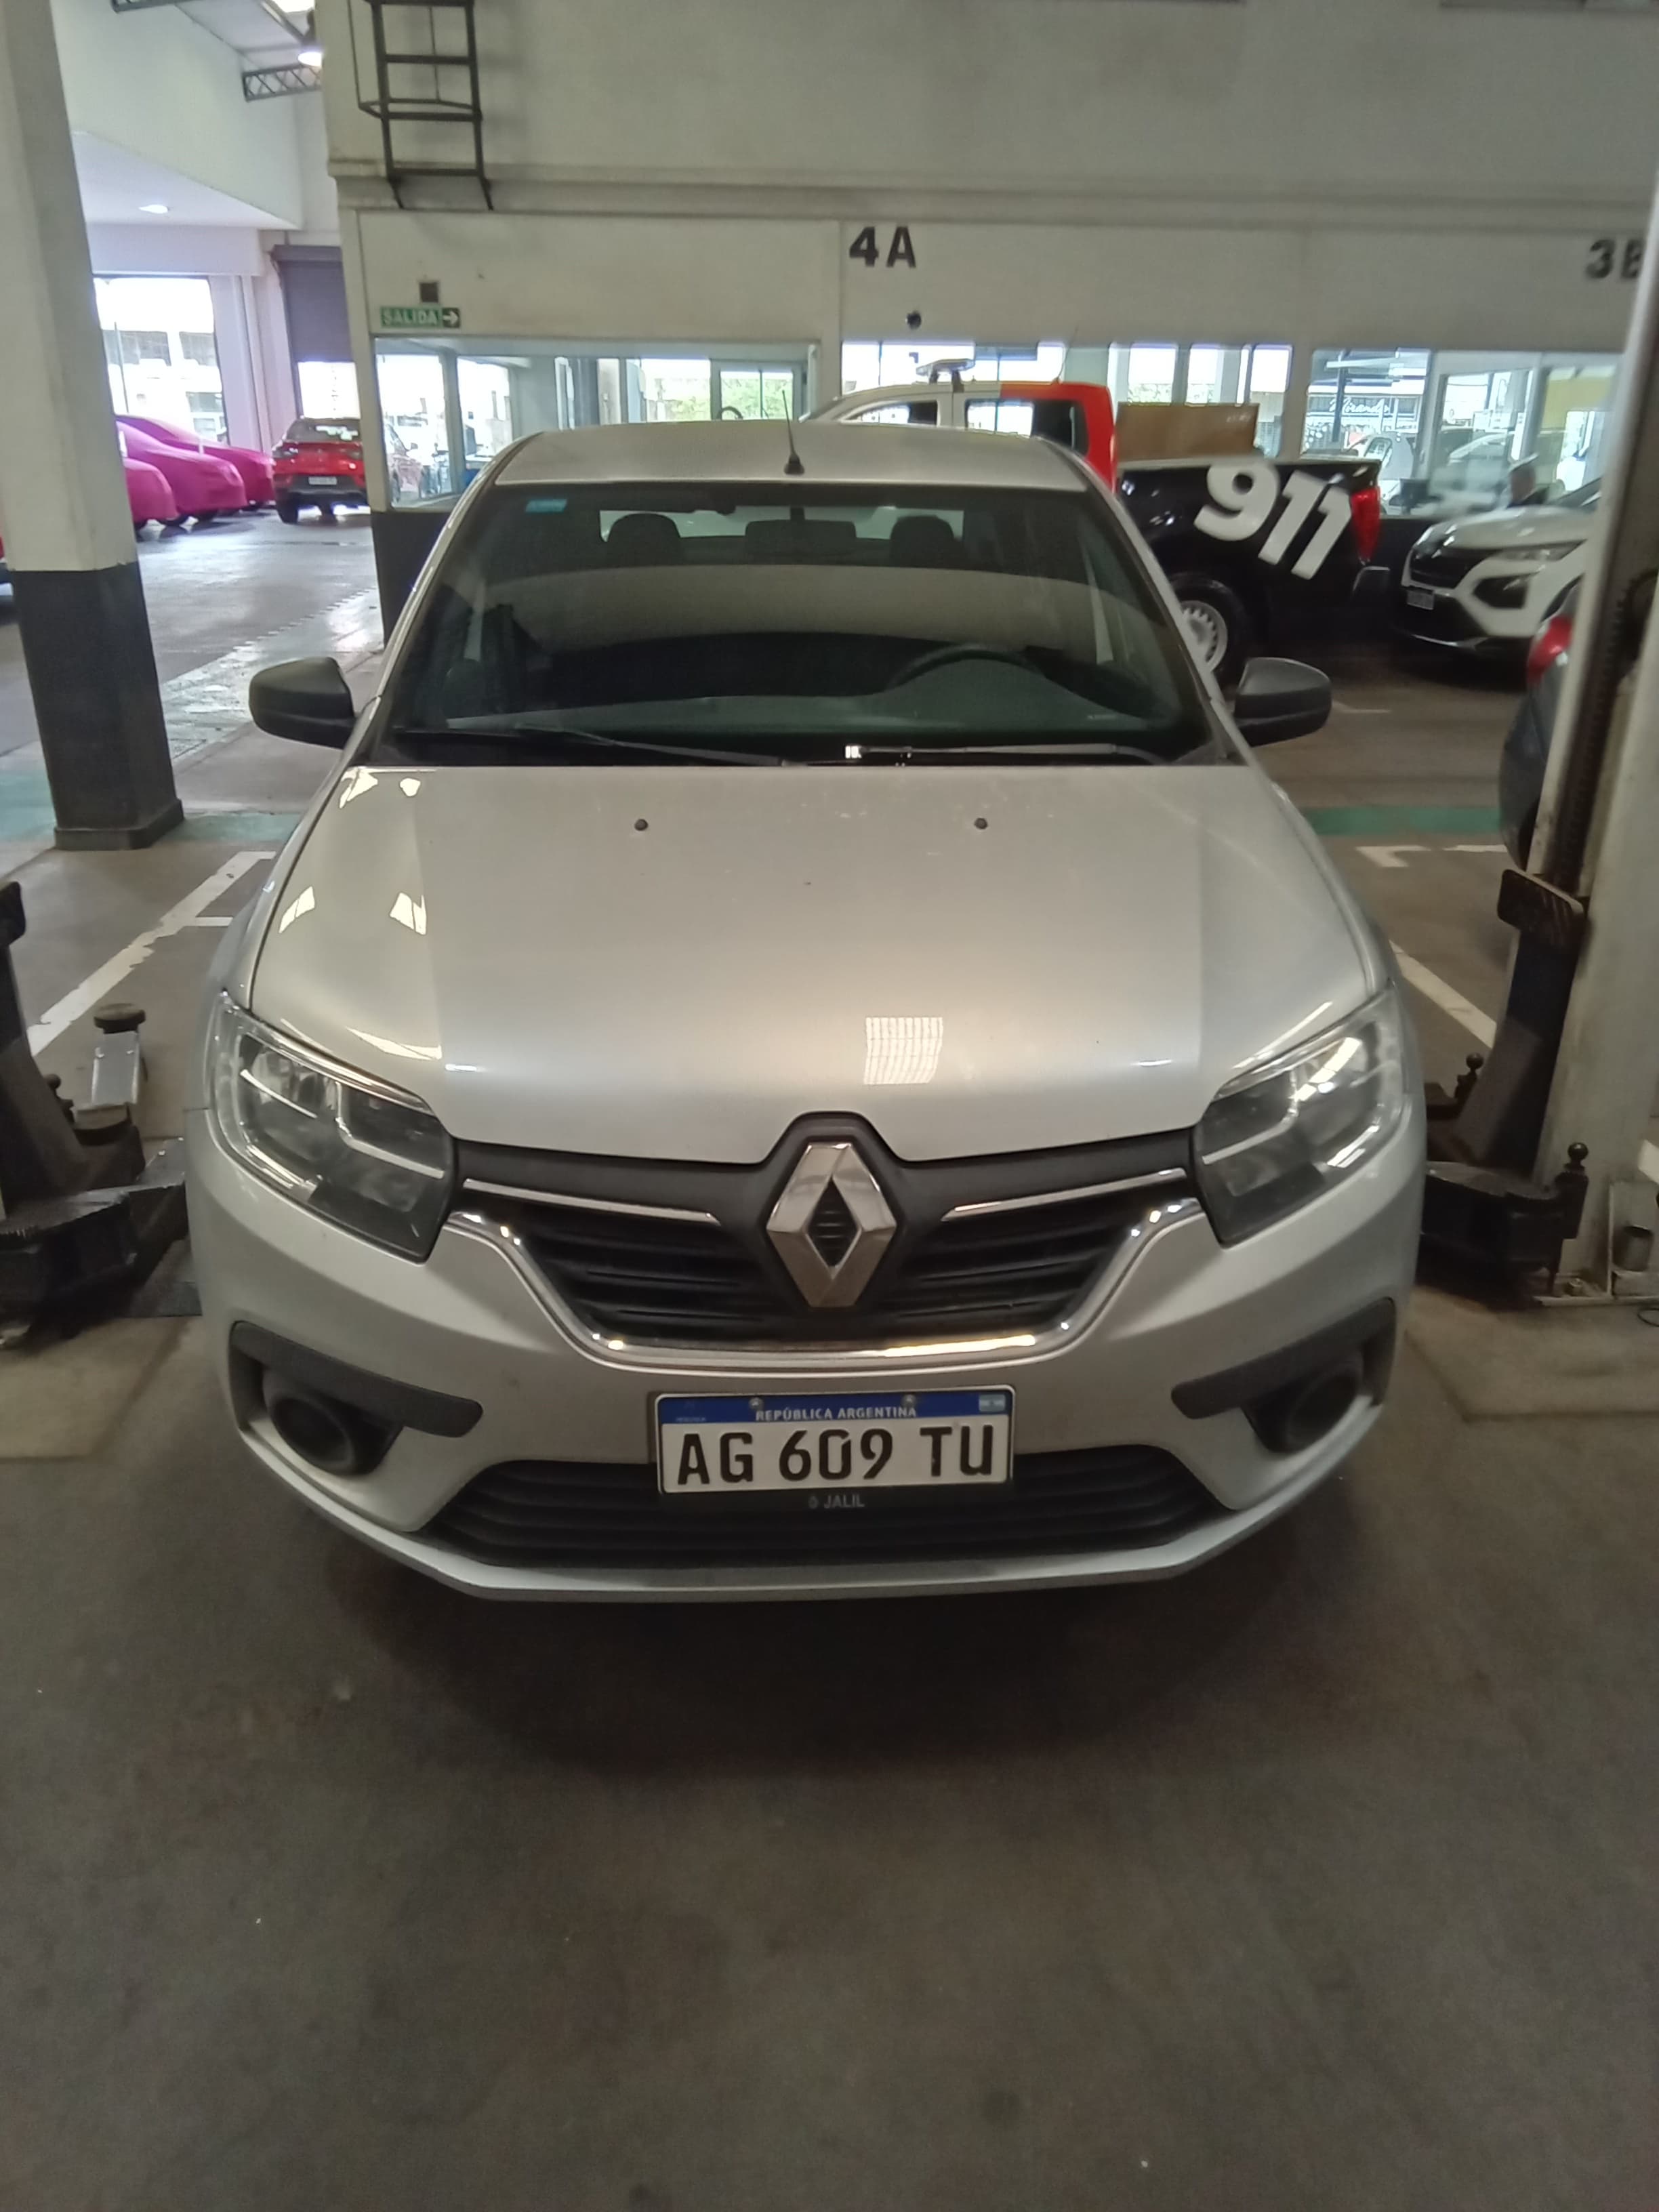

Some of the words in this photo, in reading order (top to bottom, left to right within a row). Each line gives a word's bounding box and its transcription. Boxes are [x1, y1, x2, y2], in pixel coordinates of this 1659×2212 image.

[382, 309, 438, 325] SALIDA
[1193, 459, 1353, 580] 911
[755, 1408, 833, 1422] REPÚBLICA
[837, 1406, 916, 1419] ARGENTINA
[677, 1431, 754, 1486] AG
[778, 1428, 893, 1481] 609
[919, 1424, 994, 1477] TU
[823, 1494, 865, 1509] JALIL
